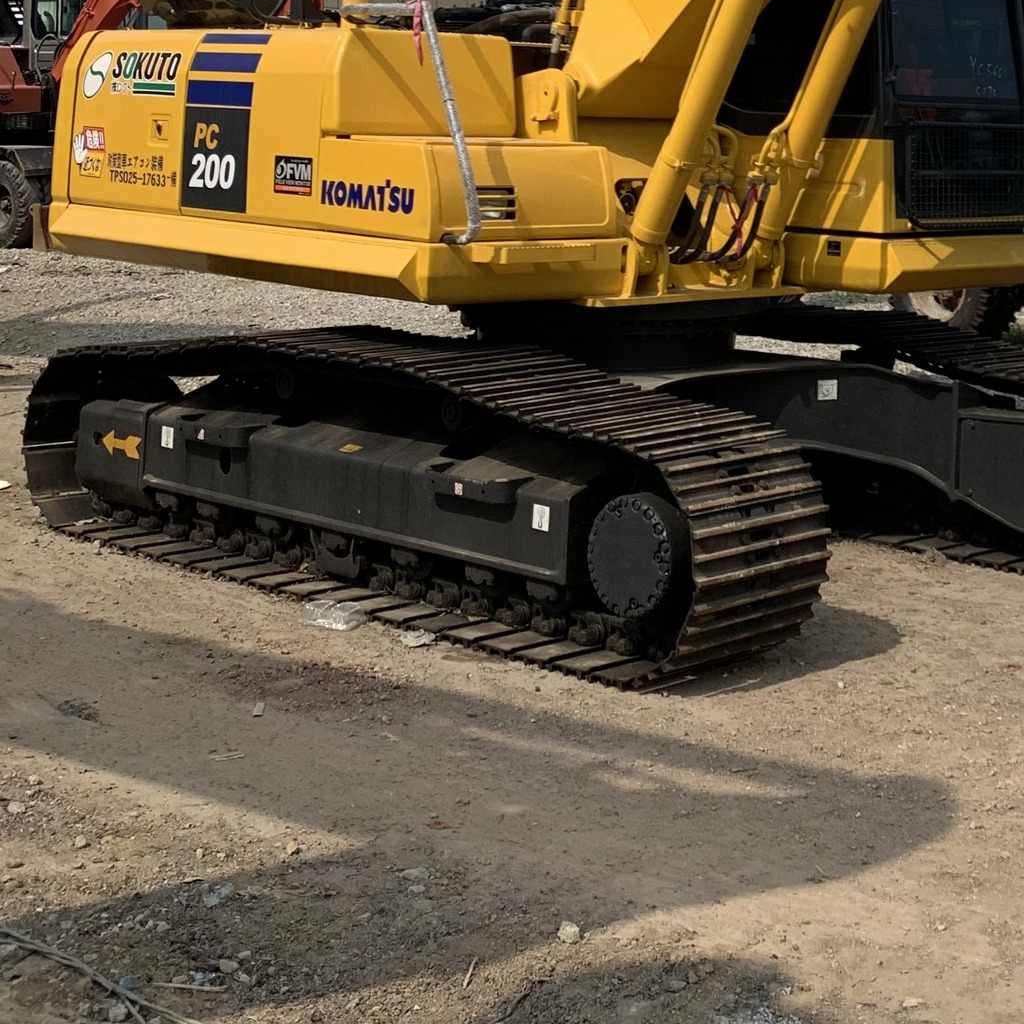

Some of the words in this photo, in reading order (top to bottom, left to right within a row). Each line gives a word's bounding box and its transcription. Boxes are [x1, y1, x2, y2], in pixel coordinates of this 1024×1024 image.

[112, 51, 182, 81] SOKUTO
[193, 122, 221, 150] PC
[188, 152, 236, 190] 200
[321, 179, 415, 215] KOMATSU
